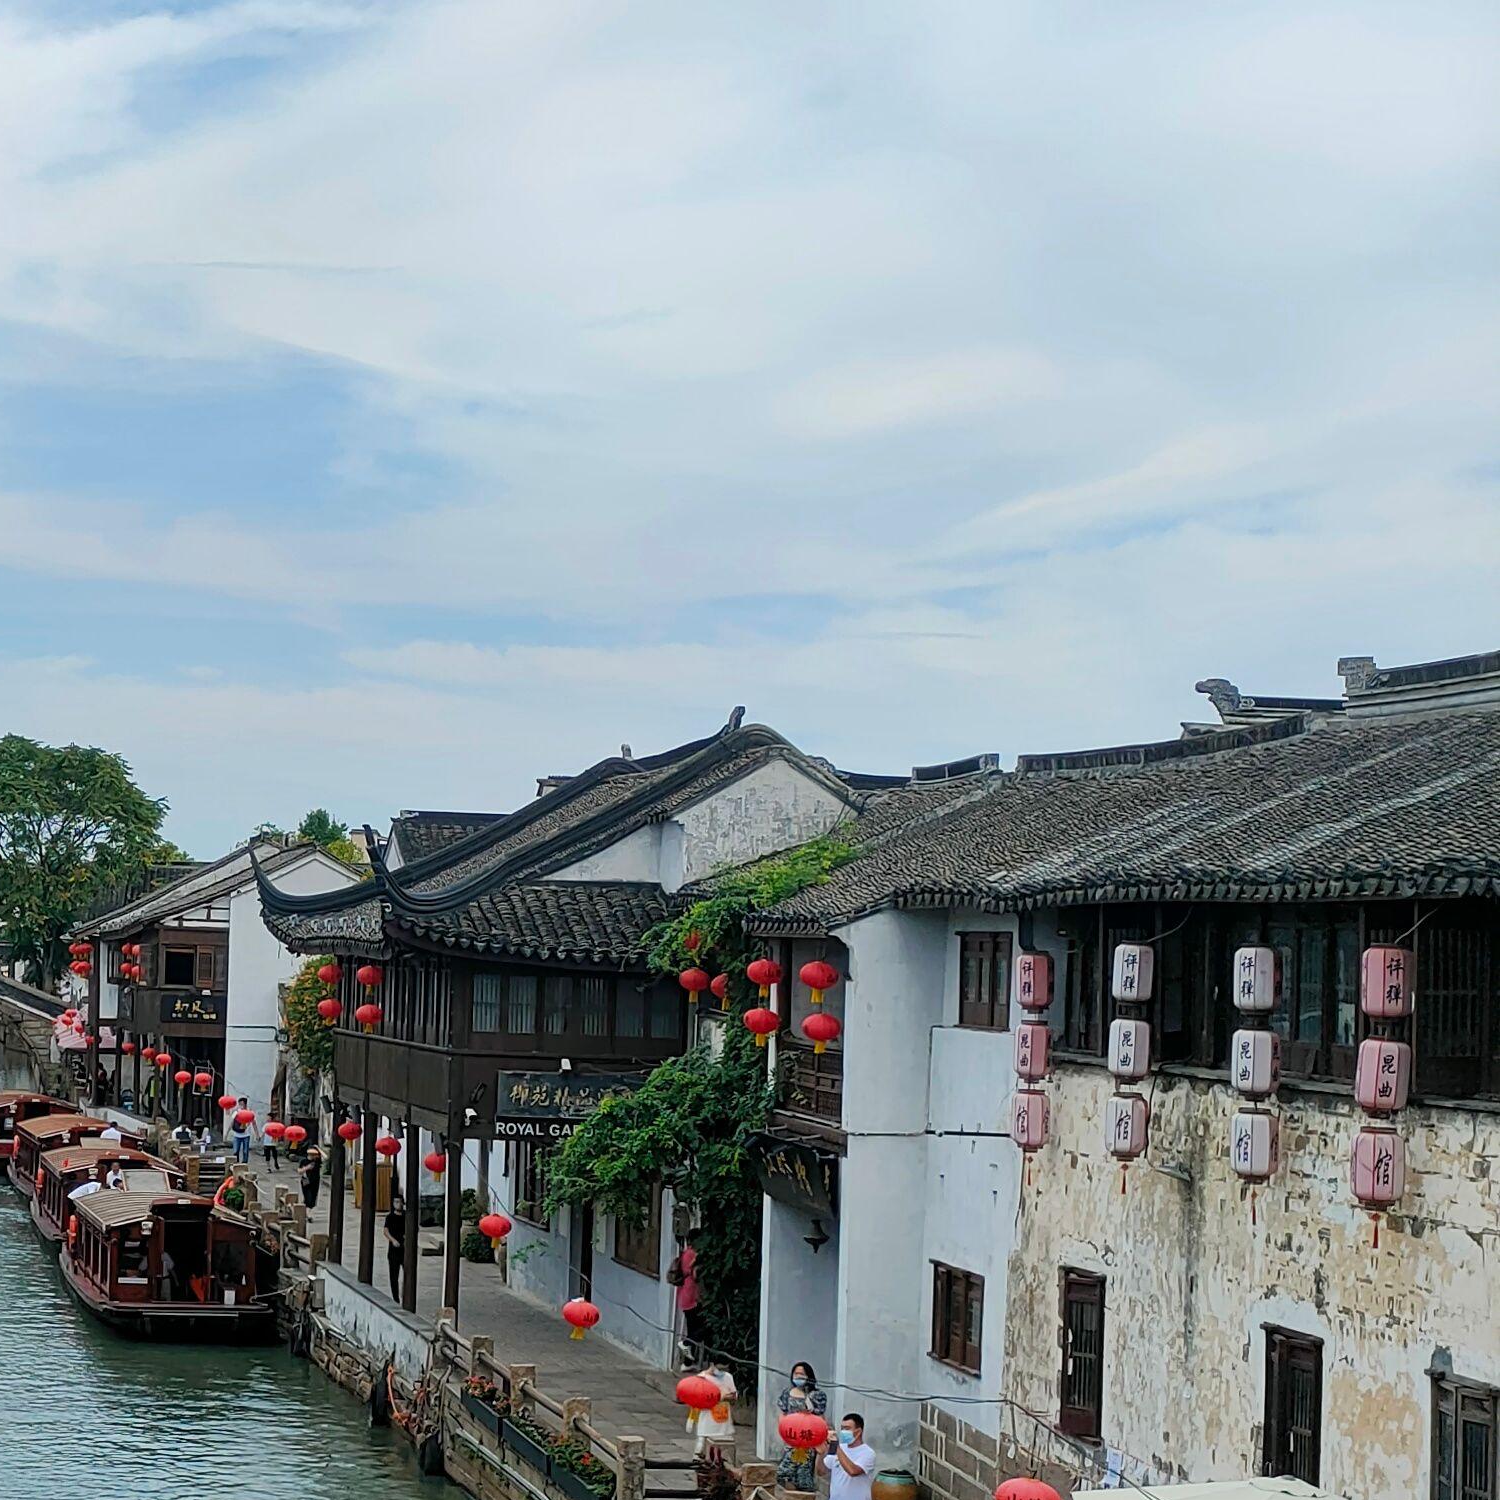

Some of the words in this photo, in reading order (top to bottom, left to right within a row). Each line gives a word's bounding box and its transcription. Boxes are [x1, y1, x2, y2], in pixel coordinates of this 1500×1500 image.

[1120, 1031, 1134, 1067] 昆曲
[1238, 1042, 1251, 1082] 昆曲
[1378, 1055, 1396, 1098] 昆曲
[496, 1122, 544, 1136] ROYAL
